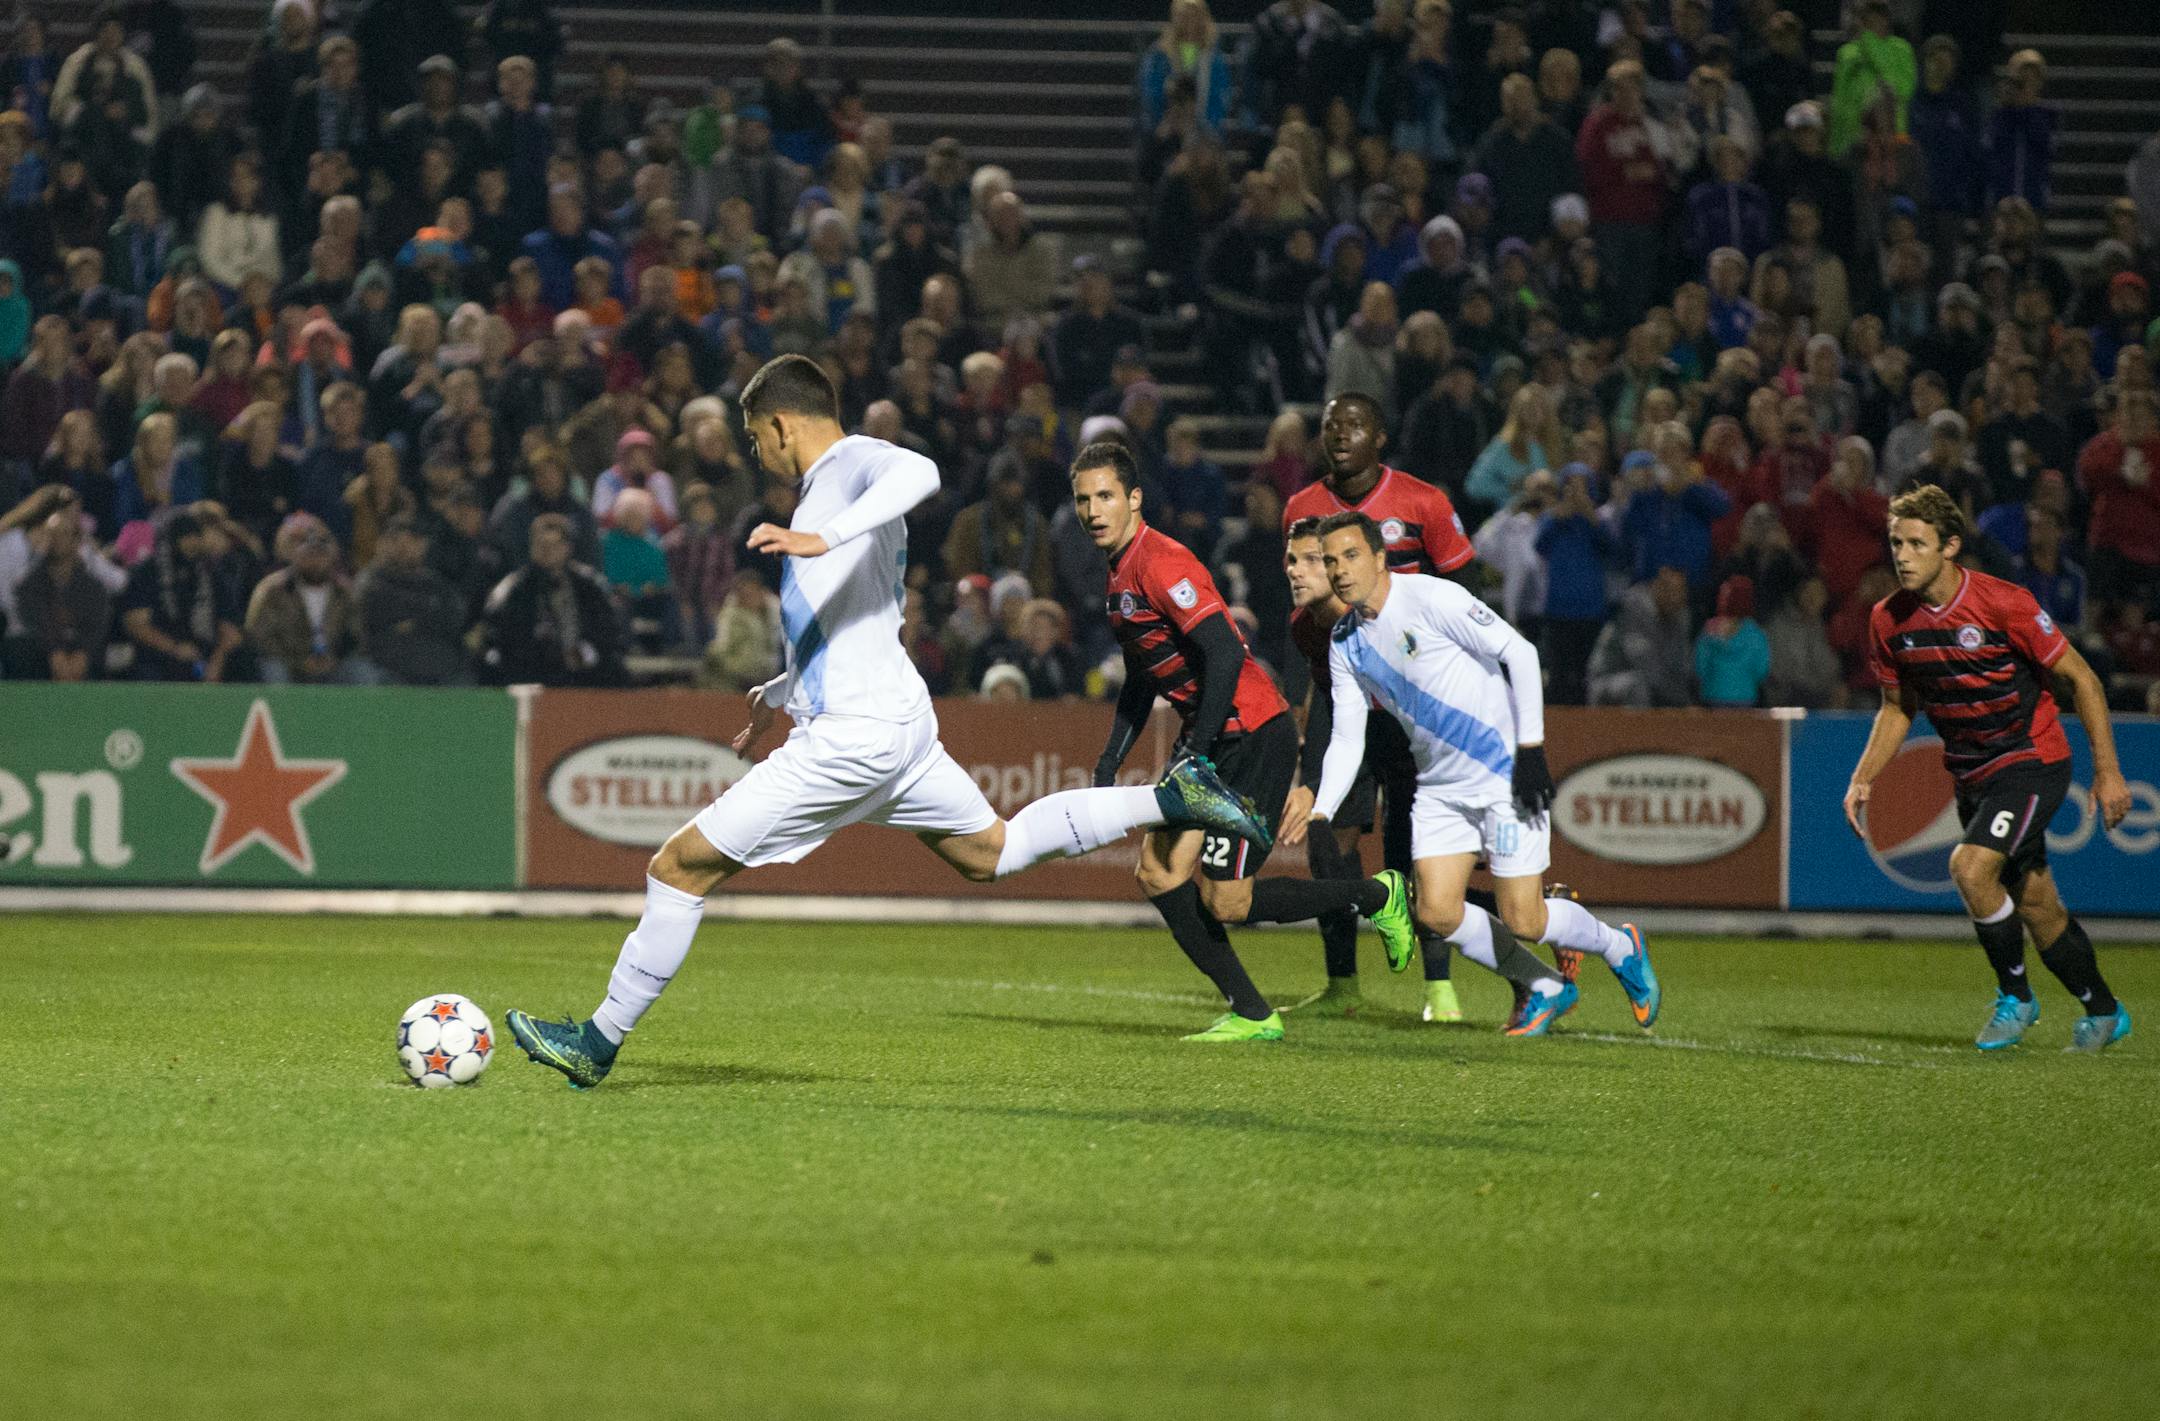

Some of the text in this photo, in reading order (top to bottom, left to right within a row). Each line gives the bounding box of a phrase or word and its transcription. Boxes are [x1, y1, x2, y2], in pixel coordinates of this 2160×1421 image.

[1571, 792, 1746, 832] STELLIAN
[1989, 809, 2016, 839] 6
[1201, 835, 1231, 868] 22
